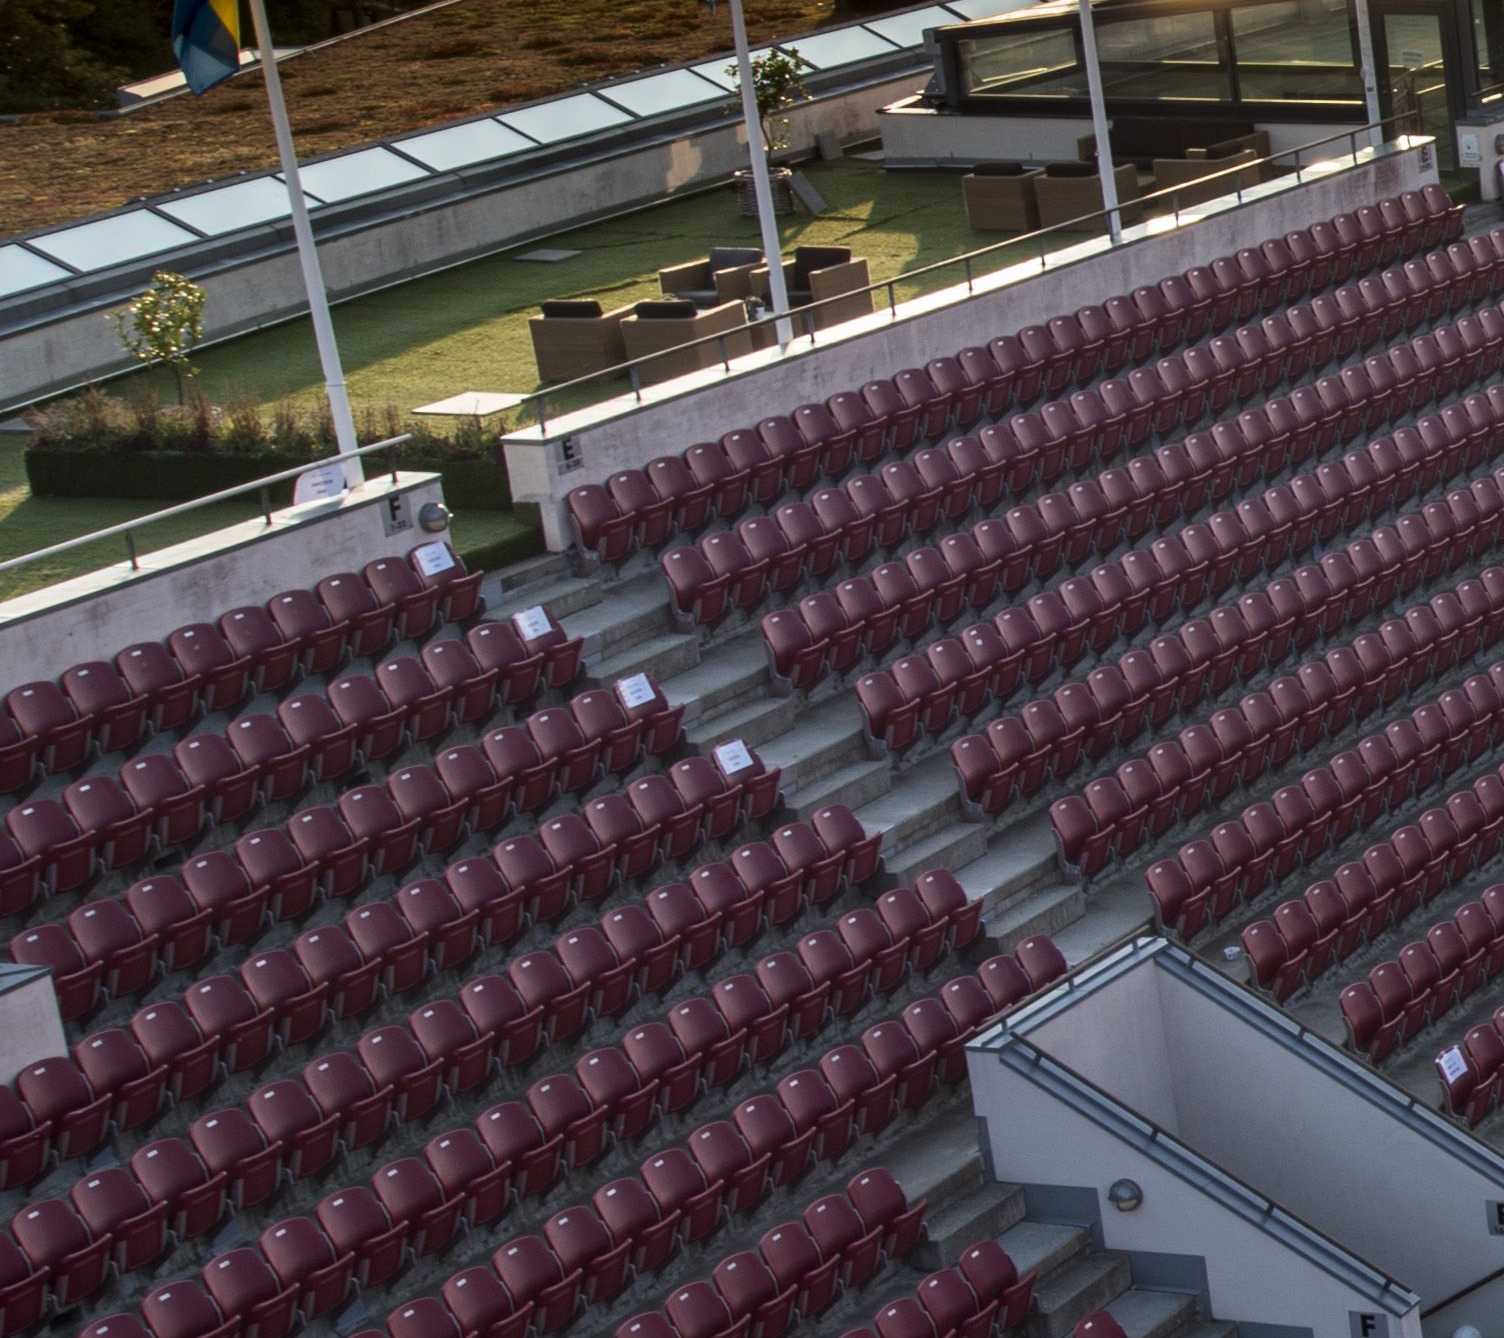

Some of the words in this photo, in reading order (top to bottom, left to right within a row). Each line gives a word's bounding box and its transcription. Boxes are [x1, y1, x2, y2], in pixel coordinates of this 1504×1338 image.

[562, 438, 574, 461] E
[389, 496, 400, 521] F
[1361, 1315, 1375, 1337] F
